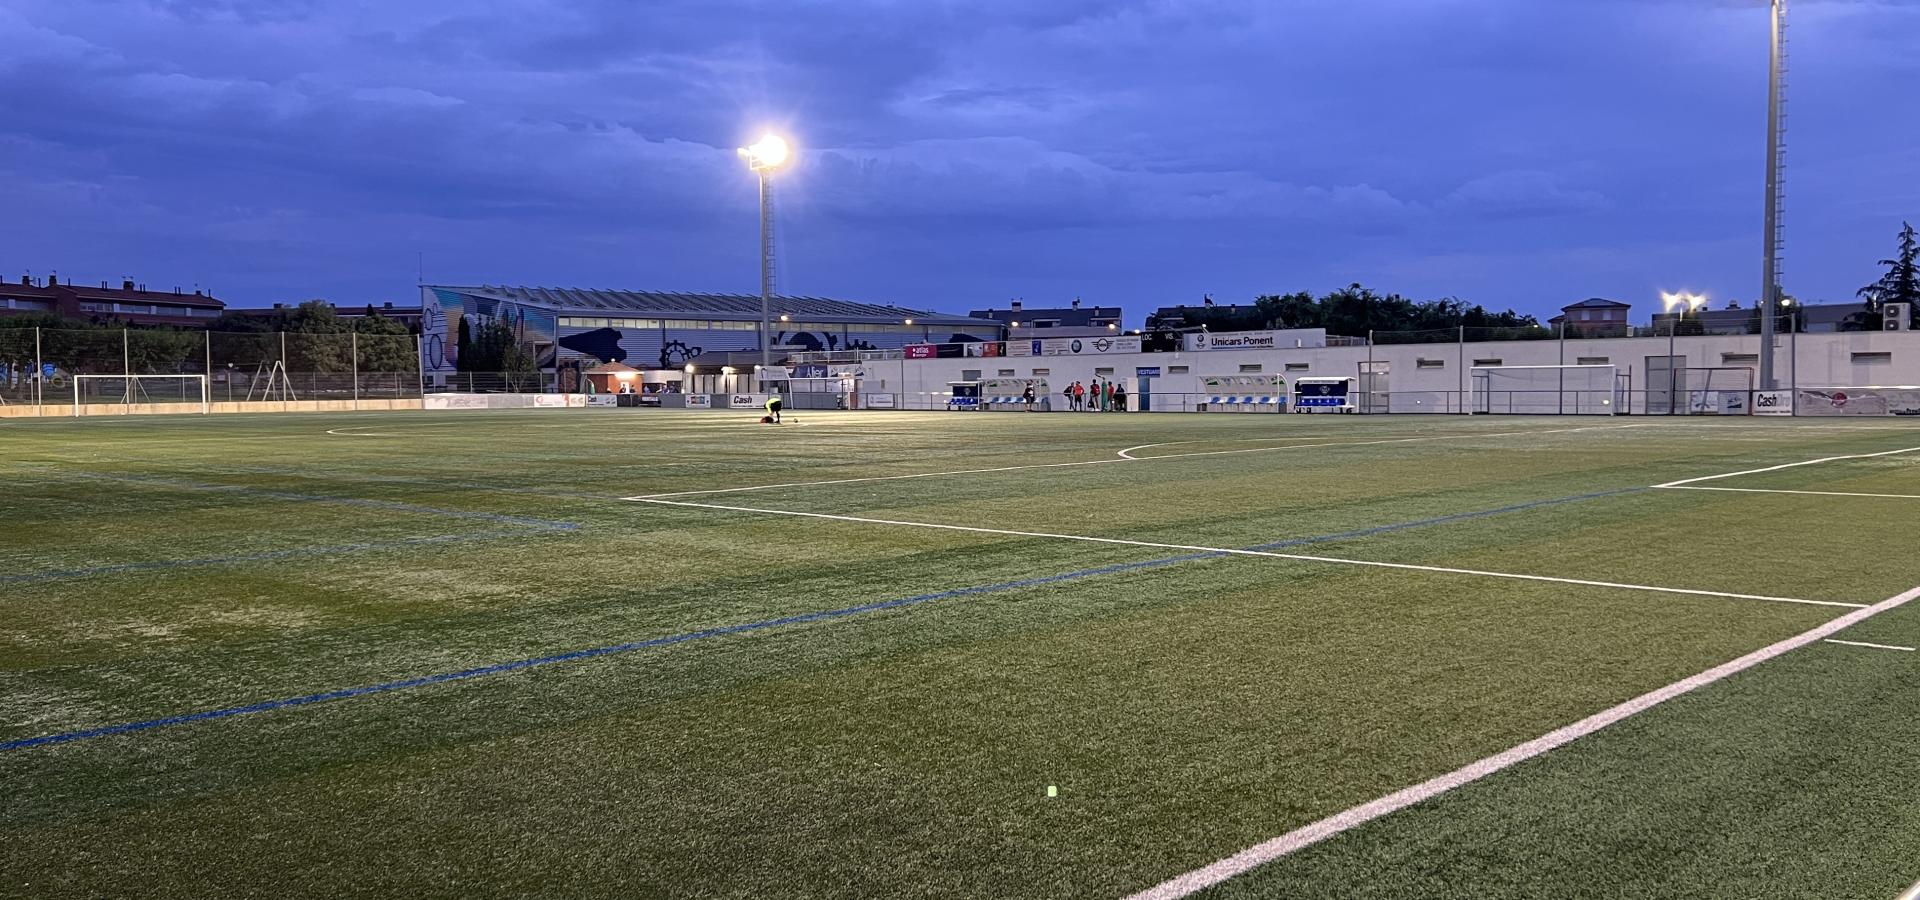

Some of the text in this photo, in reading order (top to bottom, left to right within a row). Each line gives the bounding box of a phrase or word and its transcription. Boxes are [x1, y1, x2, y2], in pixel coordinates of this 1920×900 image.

[1211, 336, 1274, 346] Unicars Ponent
[733, 395, 753, 404] Cash
